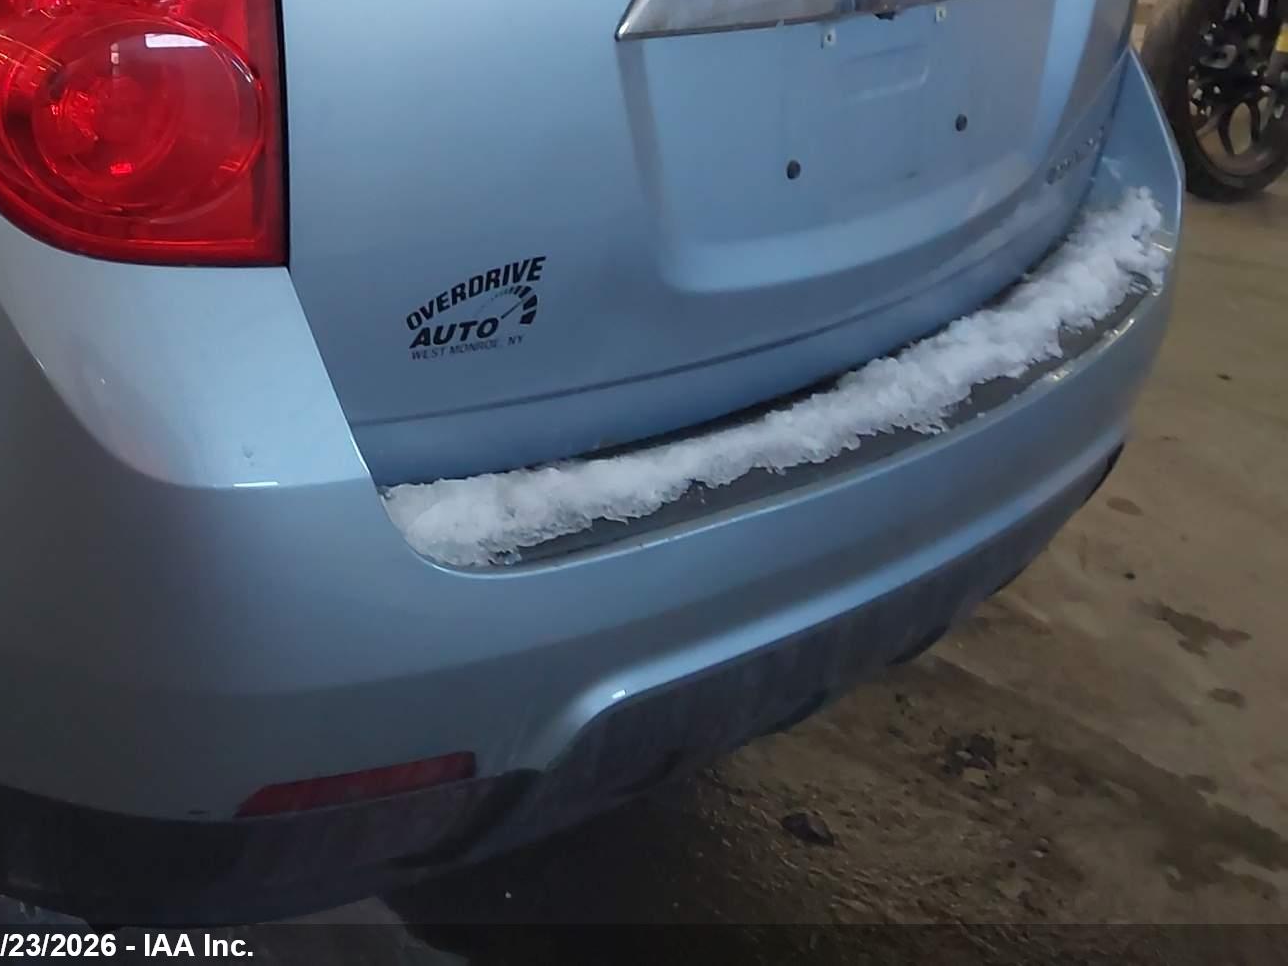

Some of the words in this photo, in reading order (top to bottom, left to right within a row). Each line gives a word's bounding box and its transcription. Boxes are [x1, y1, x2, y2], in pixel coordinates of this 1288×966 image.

[406, 256, 546, 331] OVERDRIVE
[409, 317, 499, 348] AUTO
[411, 346, 446, 361] WEST
[507, 335, 524, 346] NY
